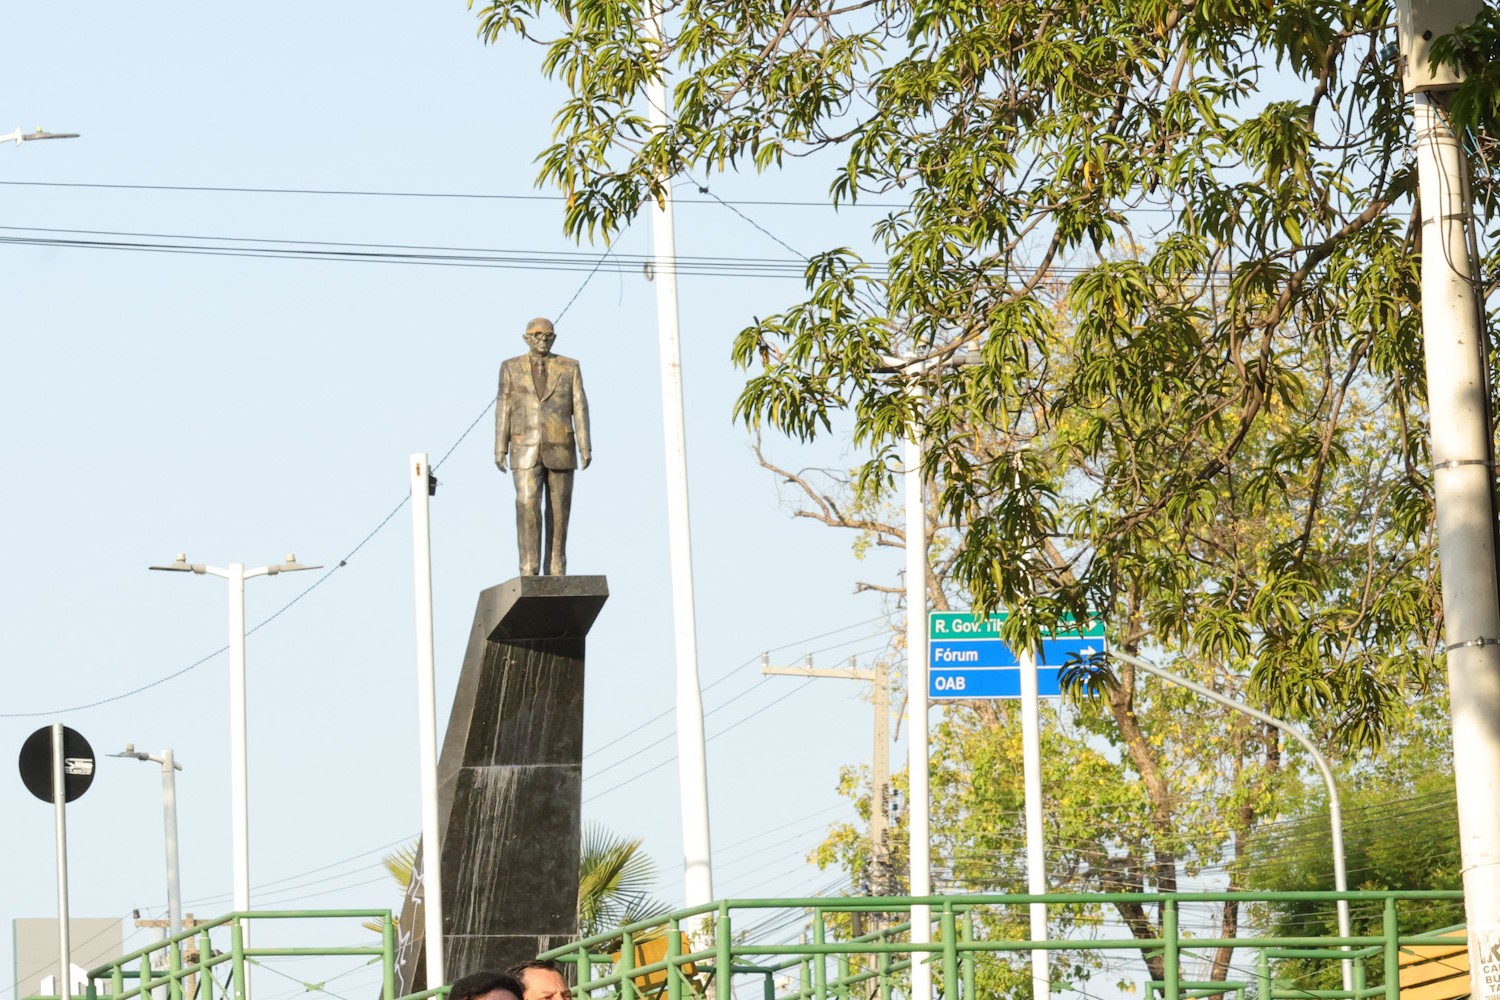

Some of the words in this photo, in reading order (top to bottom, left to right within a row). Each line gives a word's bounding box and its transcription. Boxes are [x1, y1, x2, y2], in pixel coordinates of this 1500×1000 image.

[934, 619, 949, 633] R.
[952, 618, 981, 632] Gov.
[934, 648, 978, 662] Fórum
[934, 676, 966, 690] OAB
